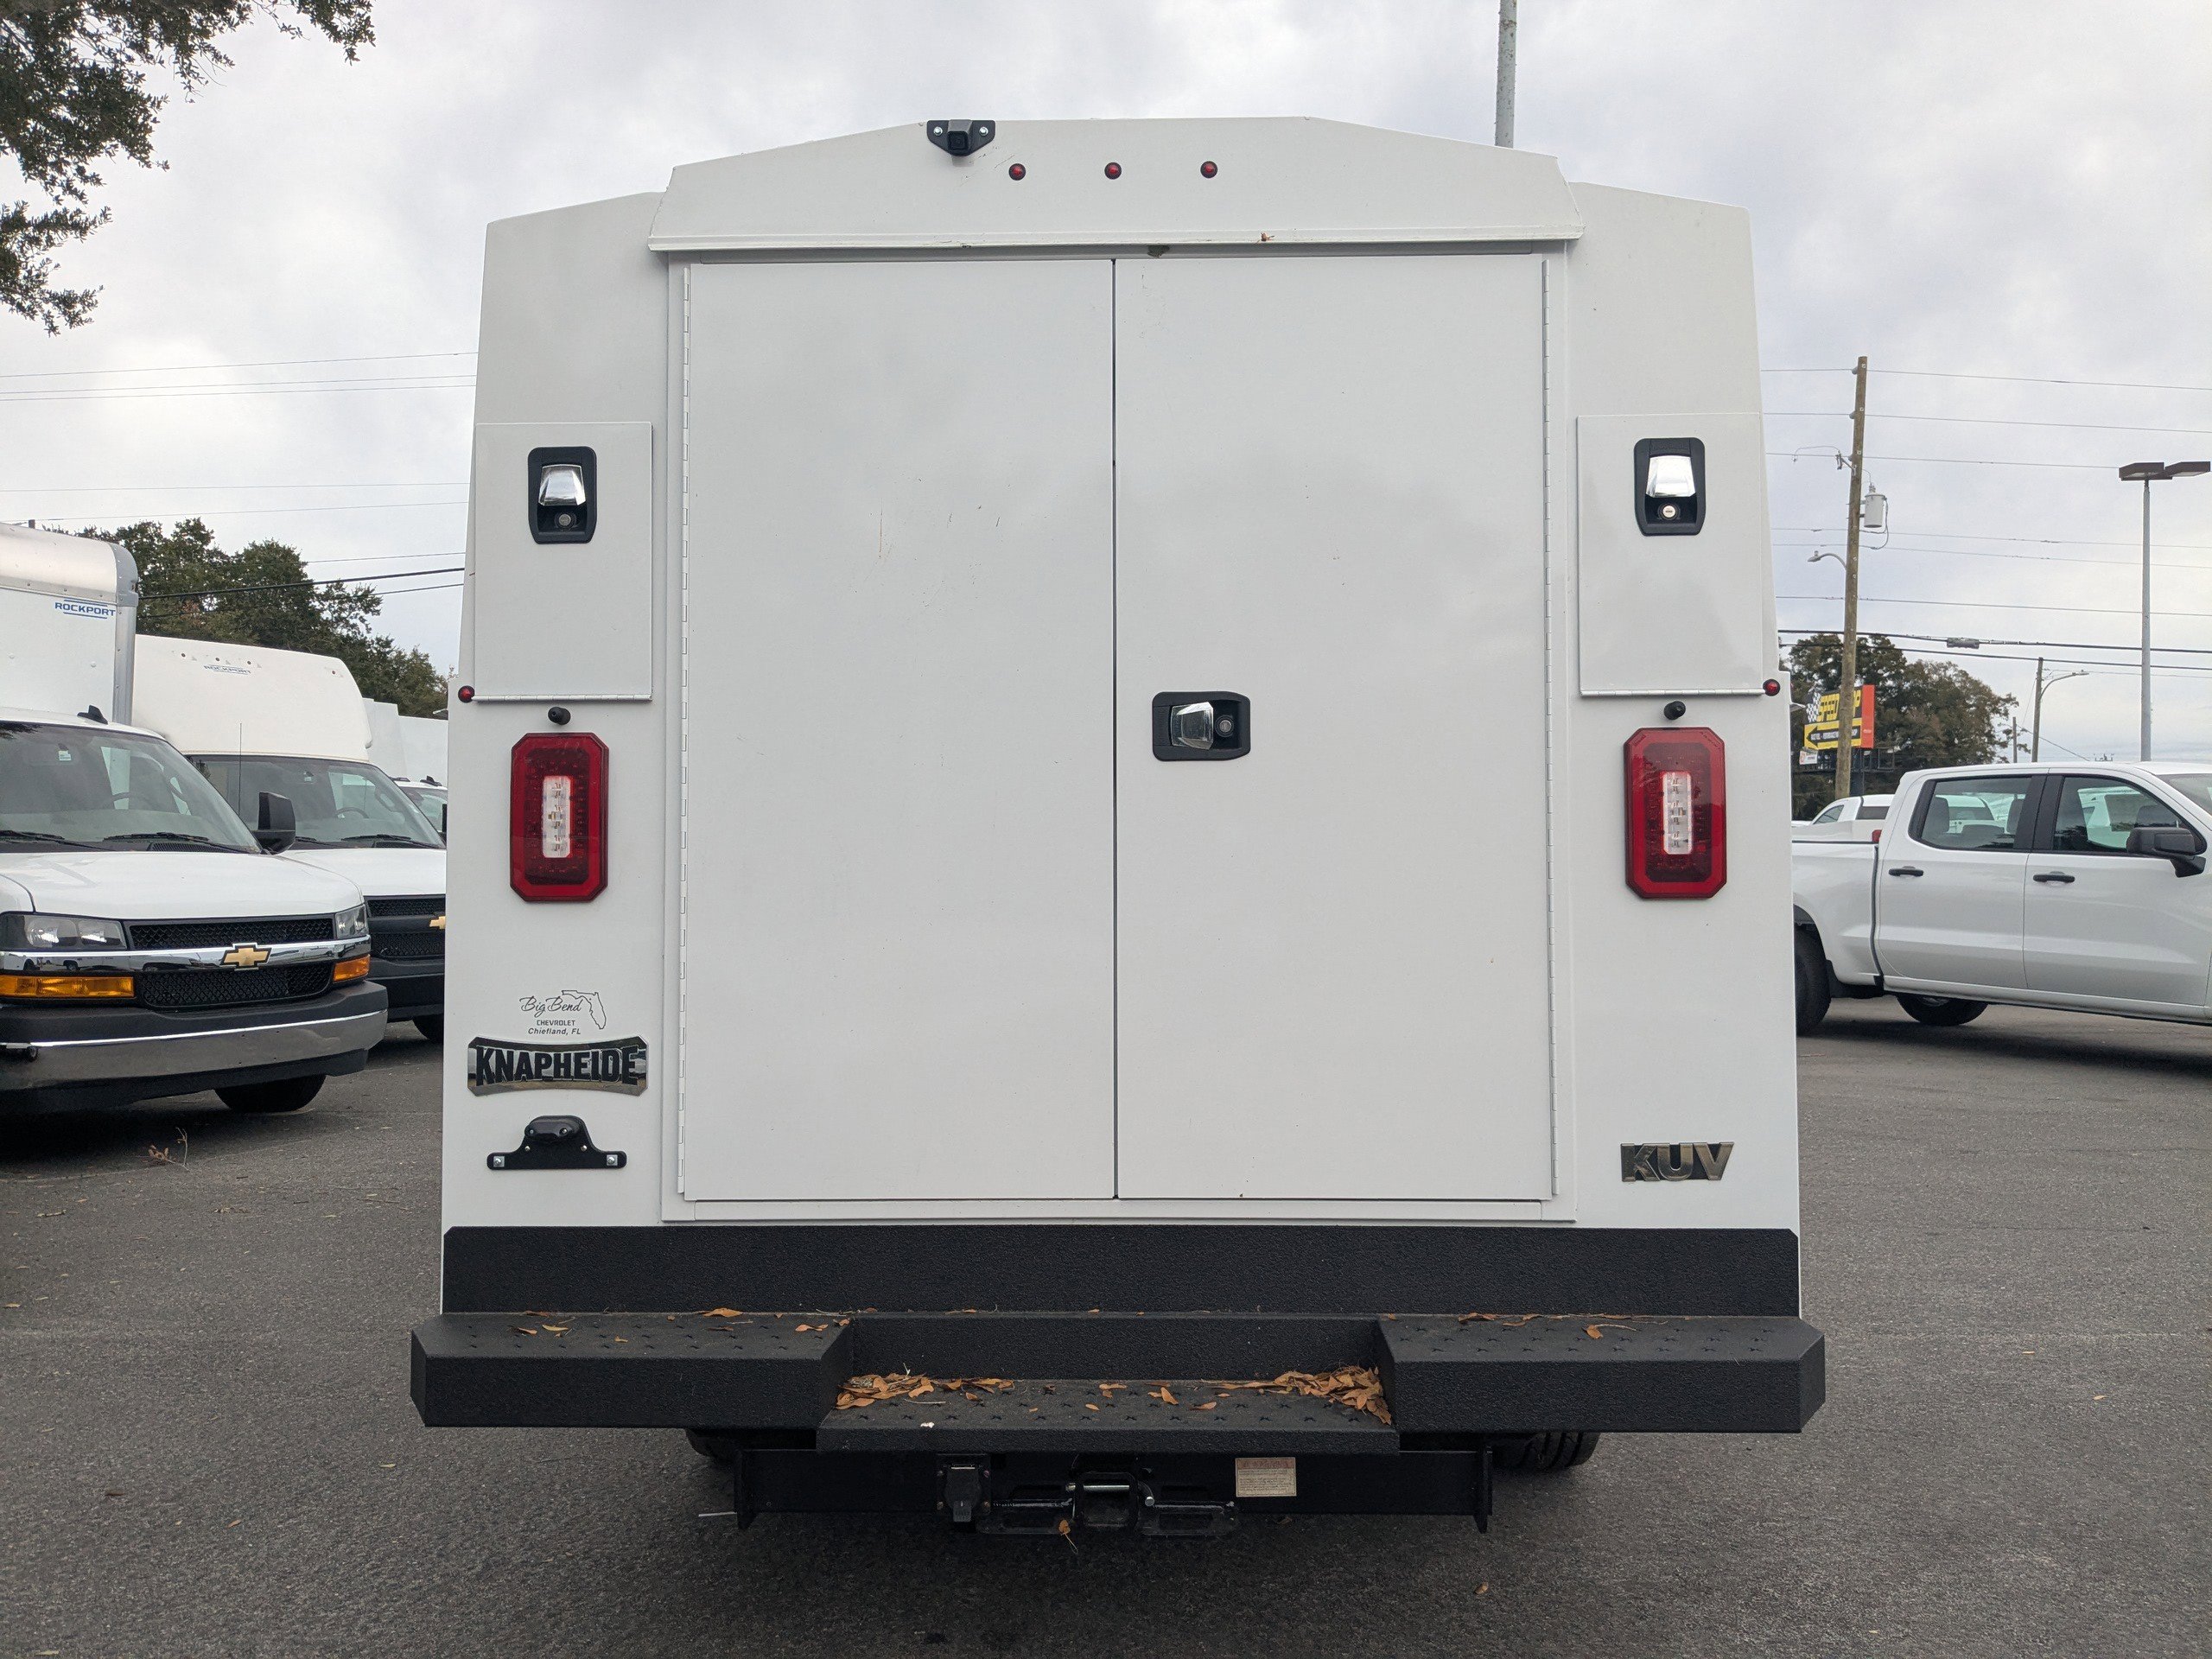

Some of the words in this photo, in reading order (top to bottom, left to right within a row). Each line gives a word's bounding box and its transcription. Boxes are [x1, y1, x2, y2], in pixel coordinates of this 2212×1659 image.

[54, 602, 116, 616] ROCKPORT
[519, 995, 546, 1018] Big
[545, 995, 583, 1012] Bend
[528, 1027, 569, 1036] Chiefland,
[475, 1045, 639, 1087] KNAPHEIDE
[1620, 1141, 1735, 1182] KUV
